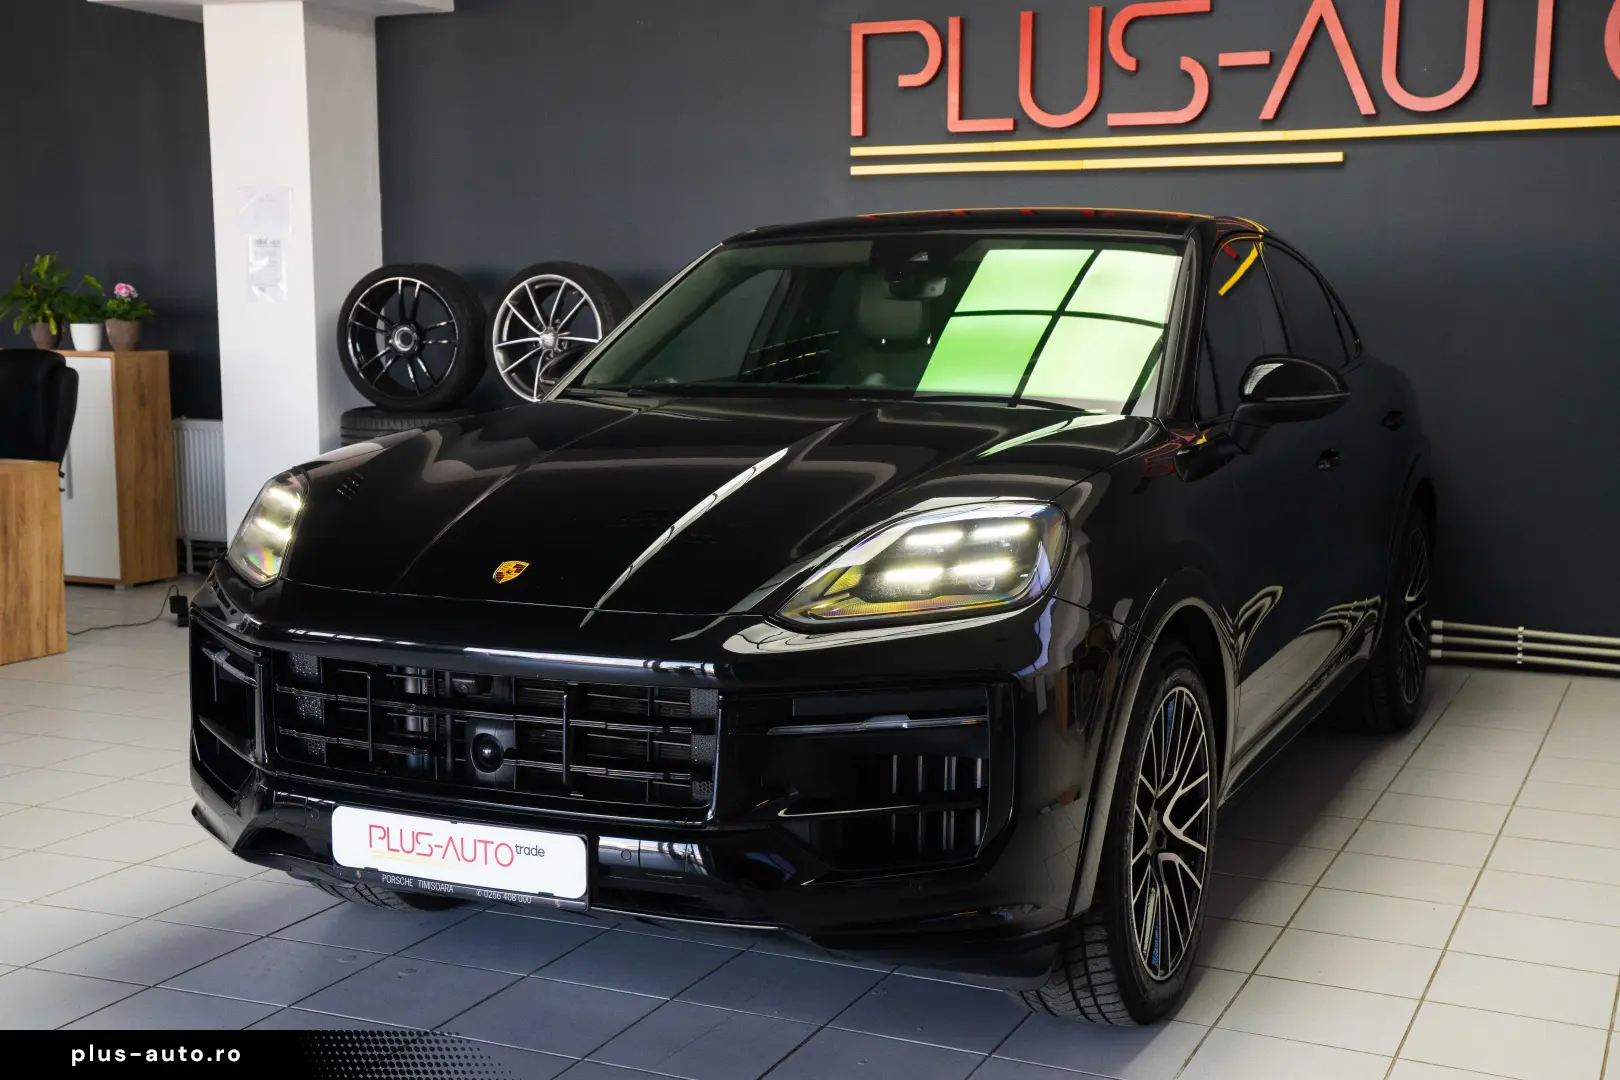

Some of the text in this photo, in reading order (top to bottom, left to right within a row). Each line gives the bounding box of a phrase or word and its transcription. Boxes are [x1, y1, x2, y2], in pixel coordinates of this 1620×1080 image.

[850, 0, 1620, 136] PLUS-AUT
[368, 824, 546, 868] PLUS-AUTO trade
[381, 873, 414, 887] PORSCHE
[418, 879, 454, 893] TIMISOARA
[483, 891, 501, 900] 0256
